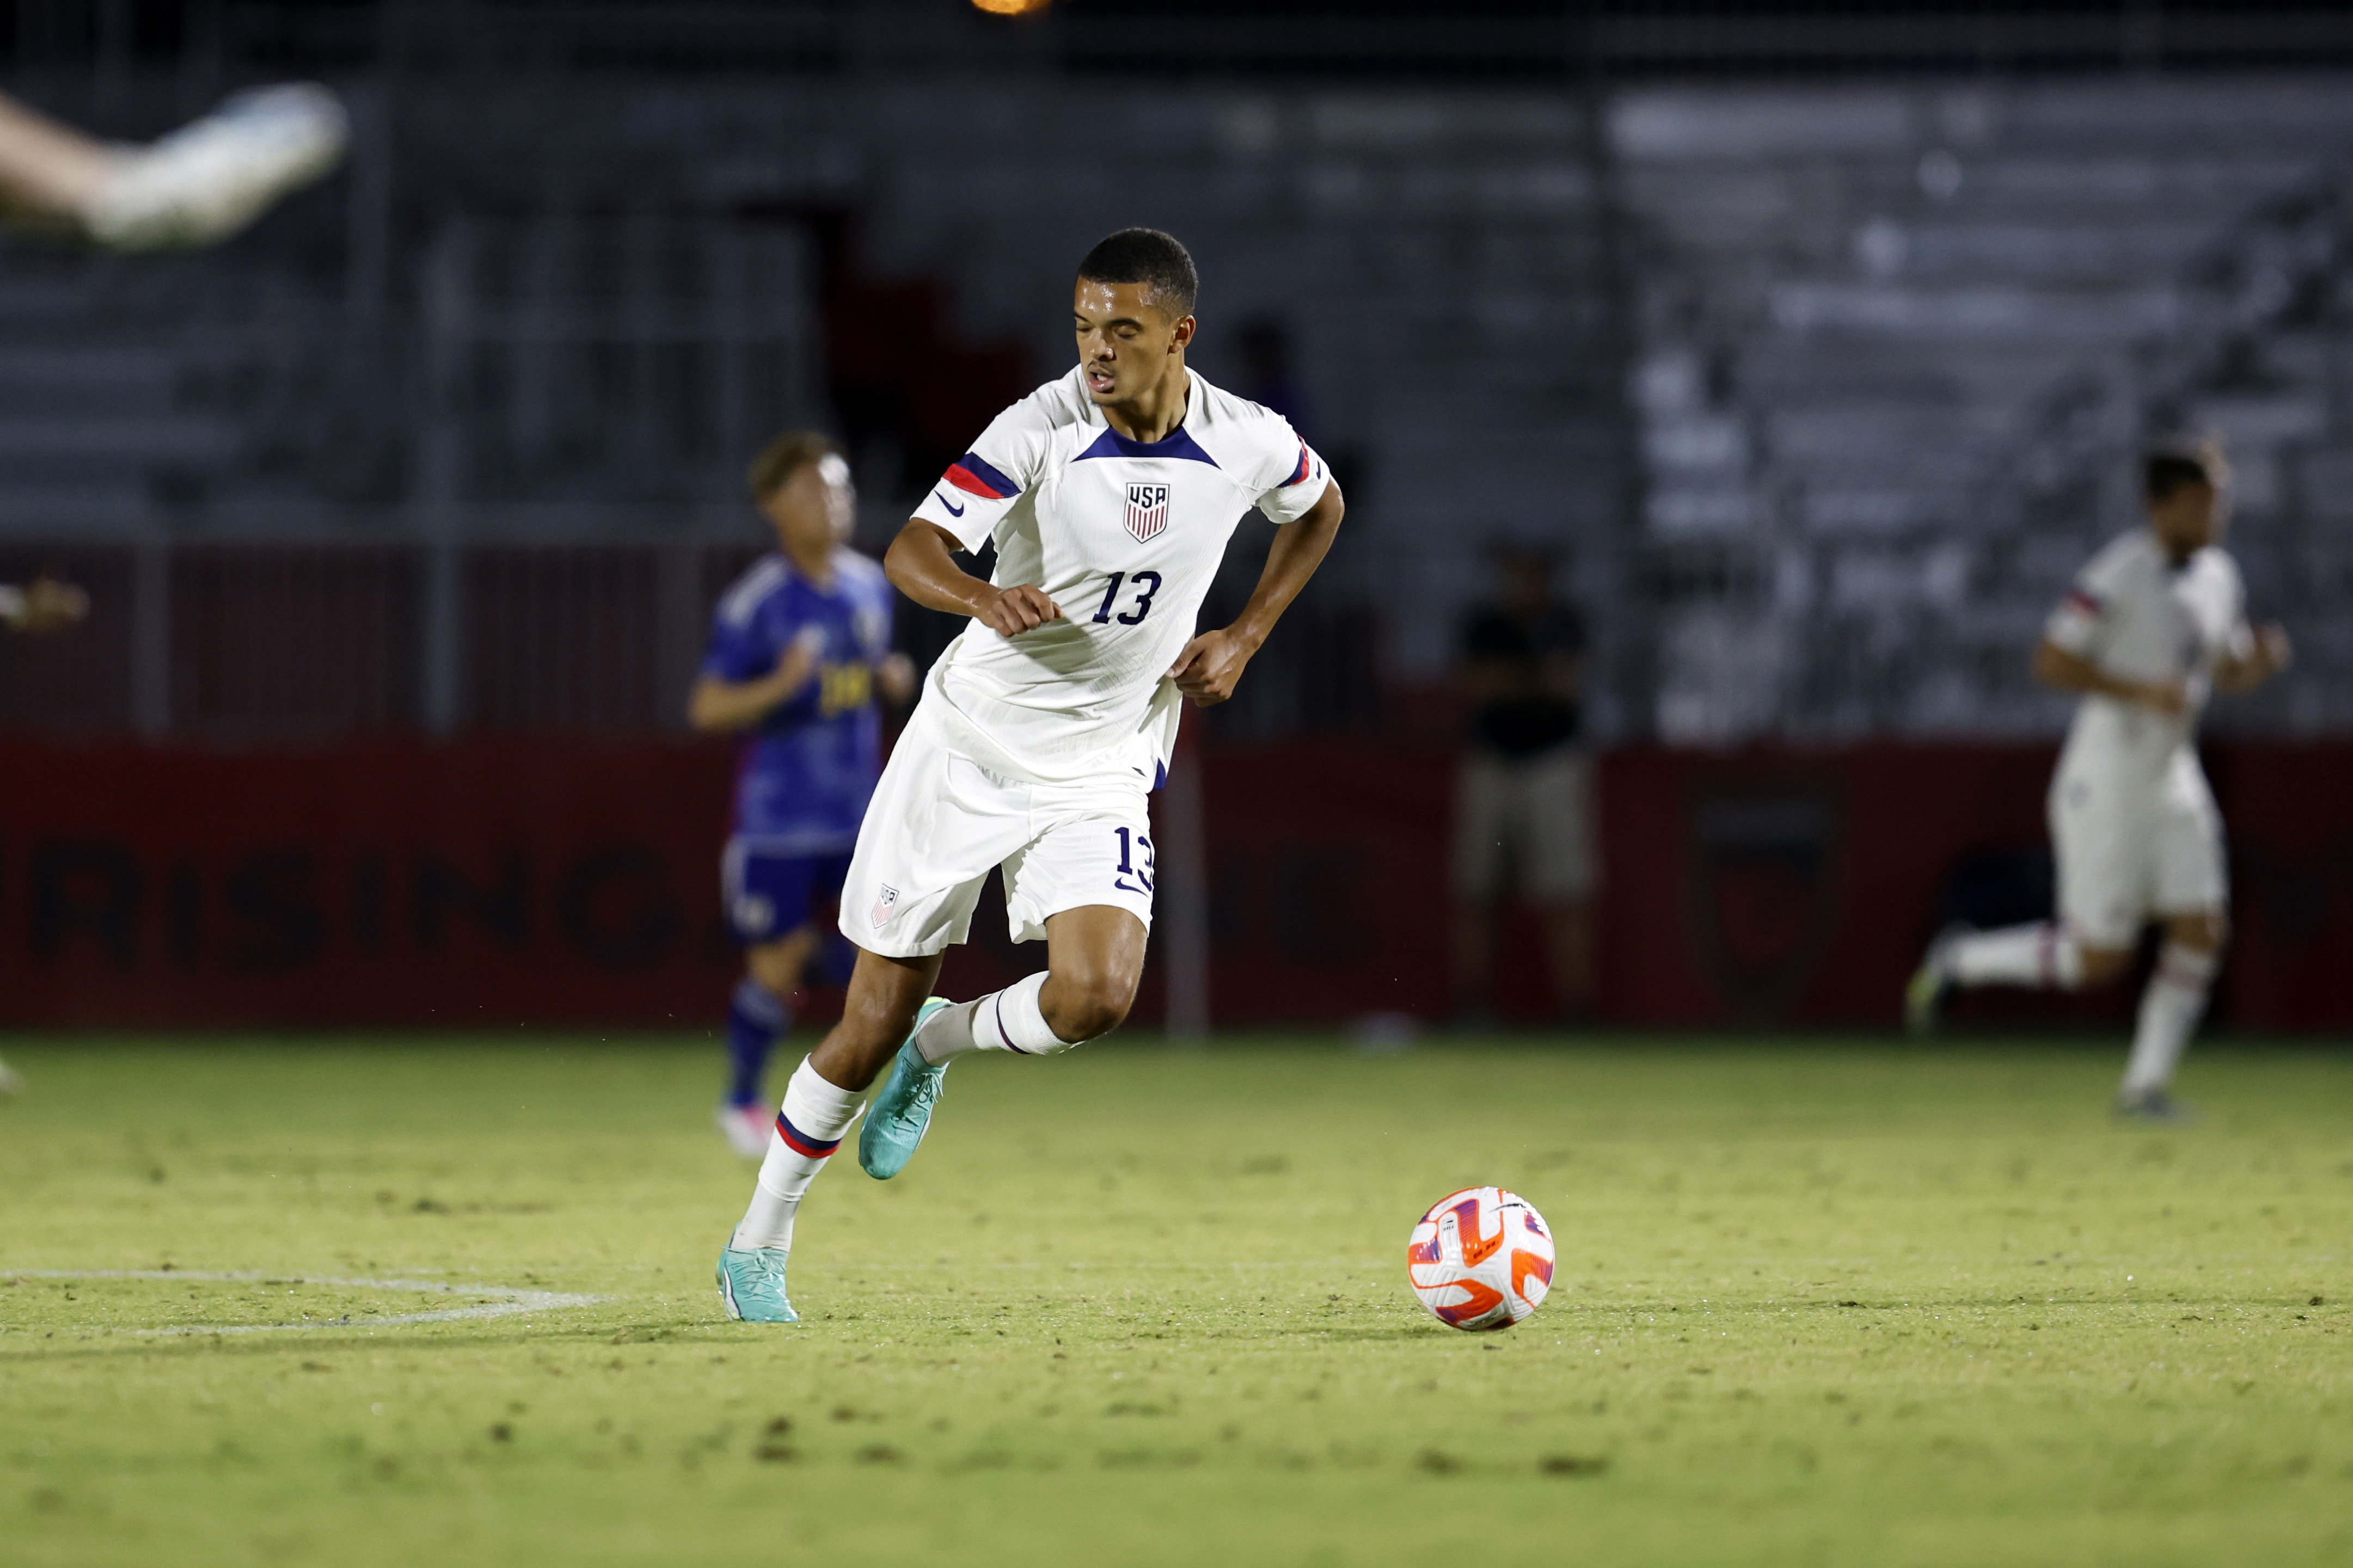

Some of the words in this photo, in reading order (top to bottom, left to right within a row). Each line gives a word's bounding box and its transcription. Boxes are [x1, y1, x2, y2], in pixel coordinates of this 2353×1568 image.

[1130, 487, 1166, 508] USA
[1092, 571, 1162, 625] 13
[1114, 827, 1153, 891] 13
